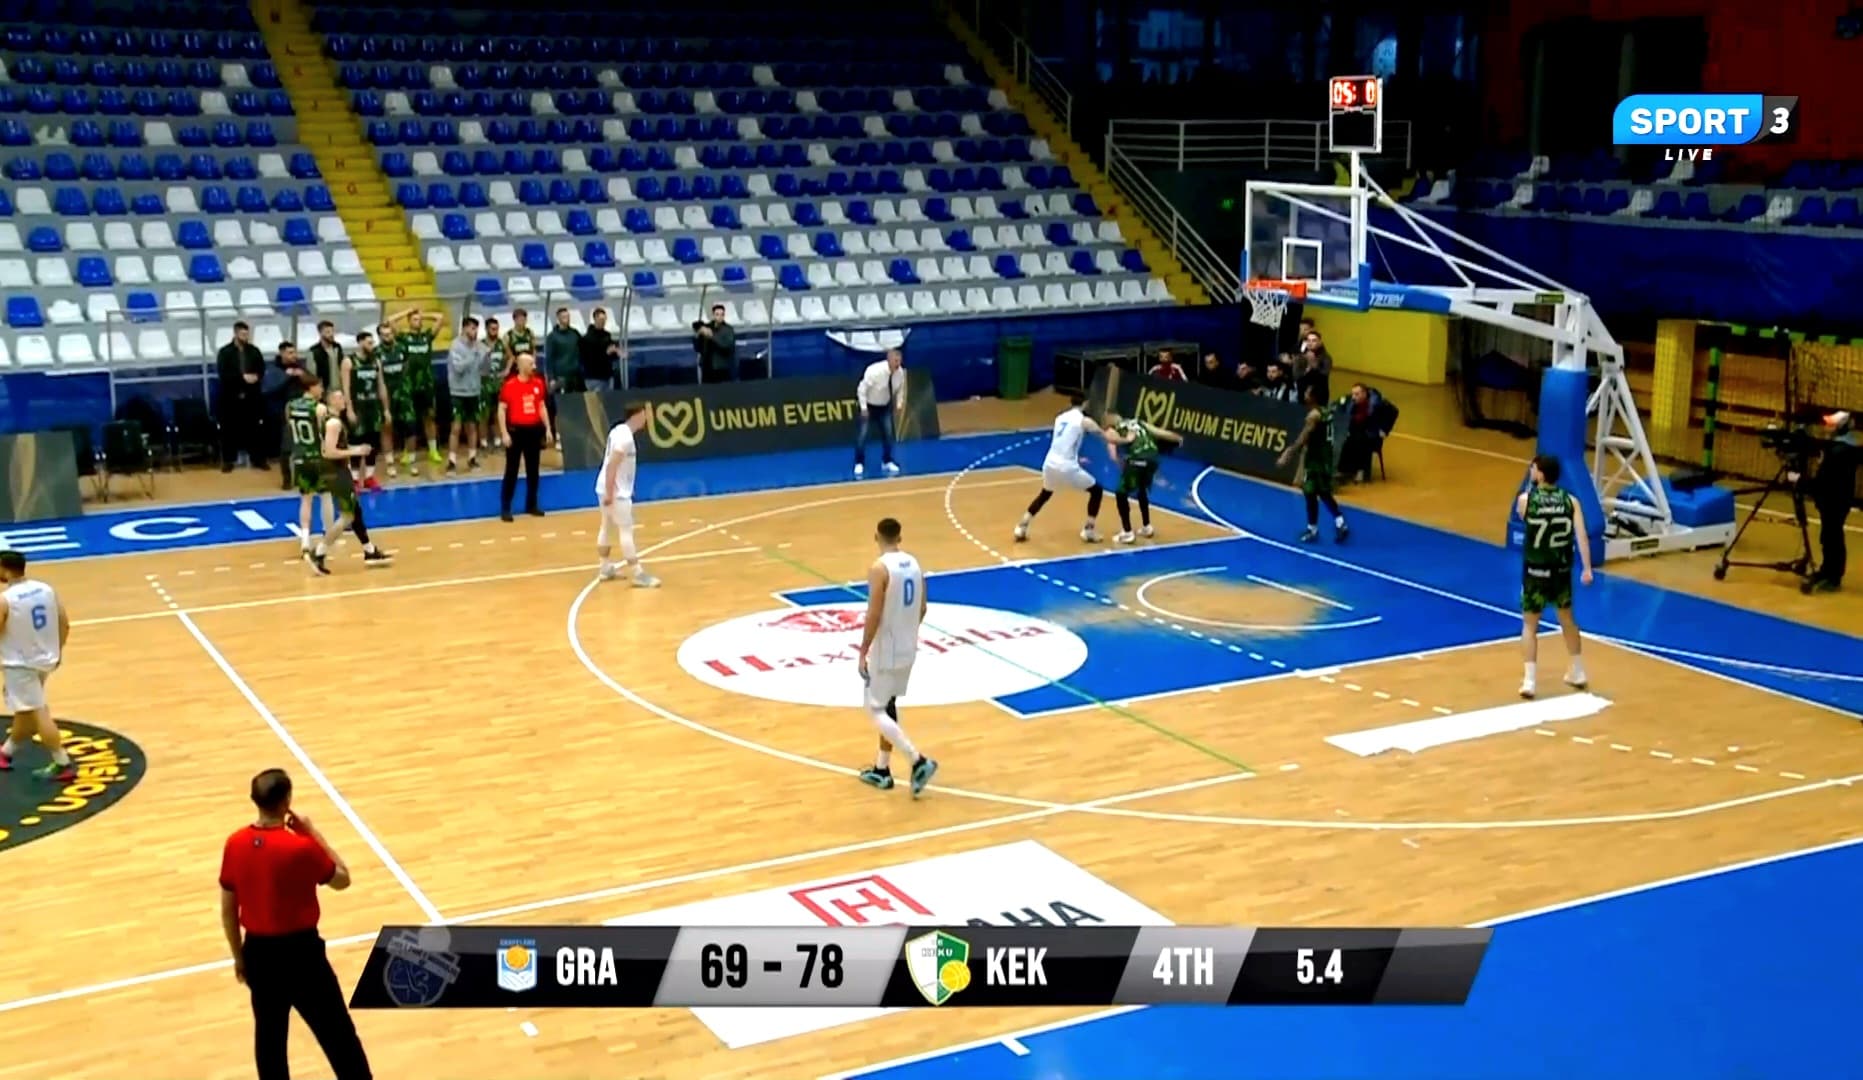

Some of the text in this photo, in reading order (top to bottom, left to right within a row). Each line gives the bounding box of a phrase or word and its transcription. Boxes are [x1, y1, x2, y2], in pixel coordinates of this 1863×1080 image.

[710, 399, 858, 431] UNUM EVENT
[1173, 407, 1288, 453] UNUM EVENTS
[289, 418, 315, 445] 10
[1527, 517, 1572, 548] 72
[903, 578, 915, 607] 0
[31, 605, 47, 631] 6
